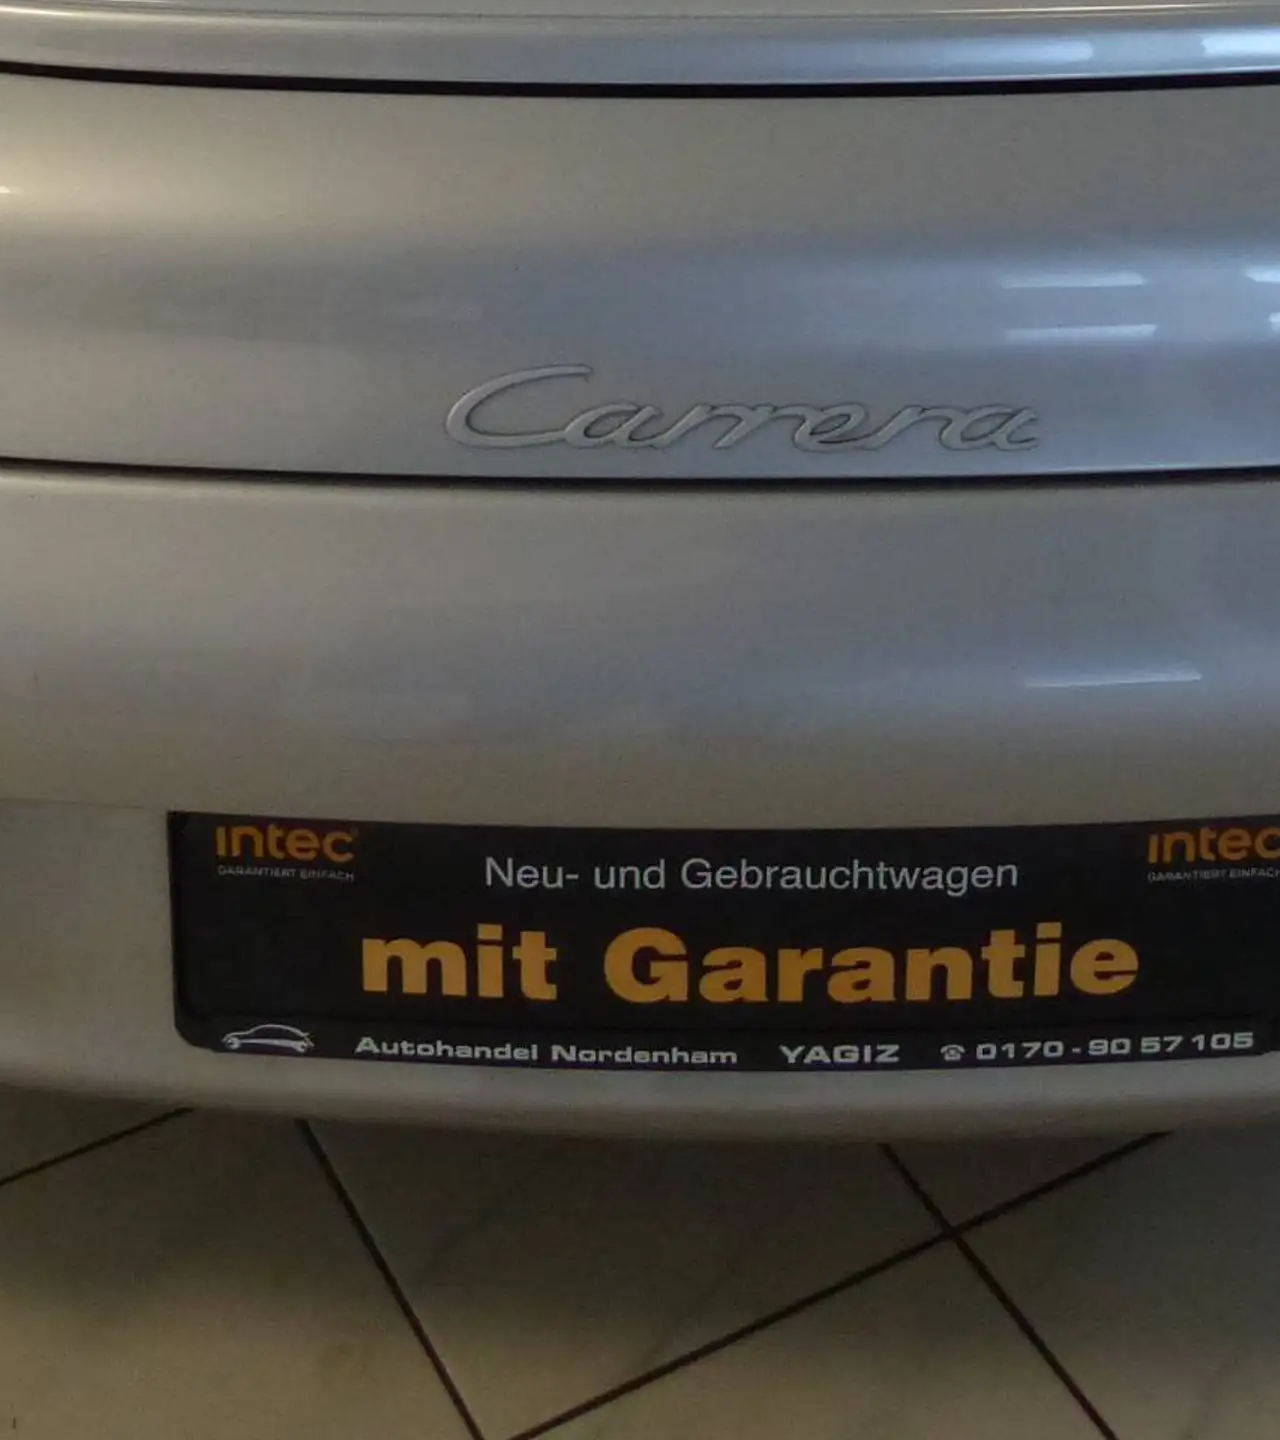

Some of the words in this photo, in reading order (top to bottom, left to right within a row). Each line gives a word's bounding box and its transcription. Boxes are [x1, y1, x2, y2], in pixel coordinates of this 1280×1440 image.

[445, 363, 1040, 450] Carrera
[216, 823, 354, 862] intec
[485, 857, 578, 889] Neu-
[594, 860, 666, 889] und
[681, 859, 1018, 897] Gebrauchtwagen
[361, 923, 558, 1001] mit
[603, 922, 1138, 1003] Garantie
[355, 1035, 538, 1060] Autohandel
[551, 1042, 737, 1065] Nordenham
[780, 1043, 900, 1063] YAGIZ
[976, 1040, 1065, 1060] 0170
[1088, 1036, 1131, 1056] 90
